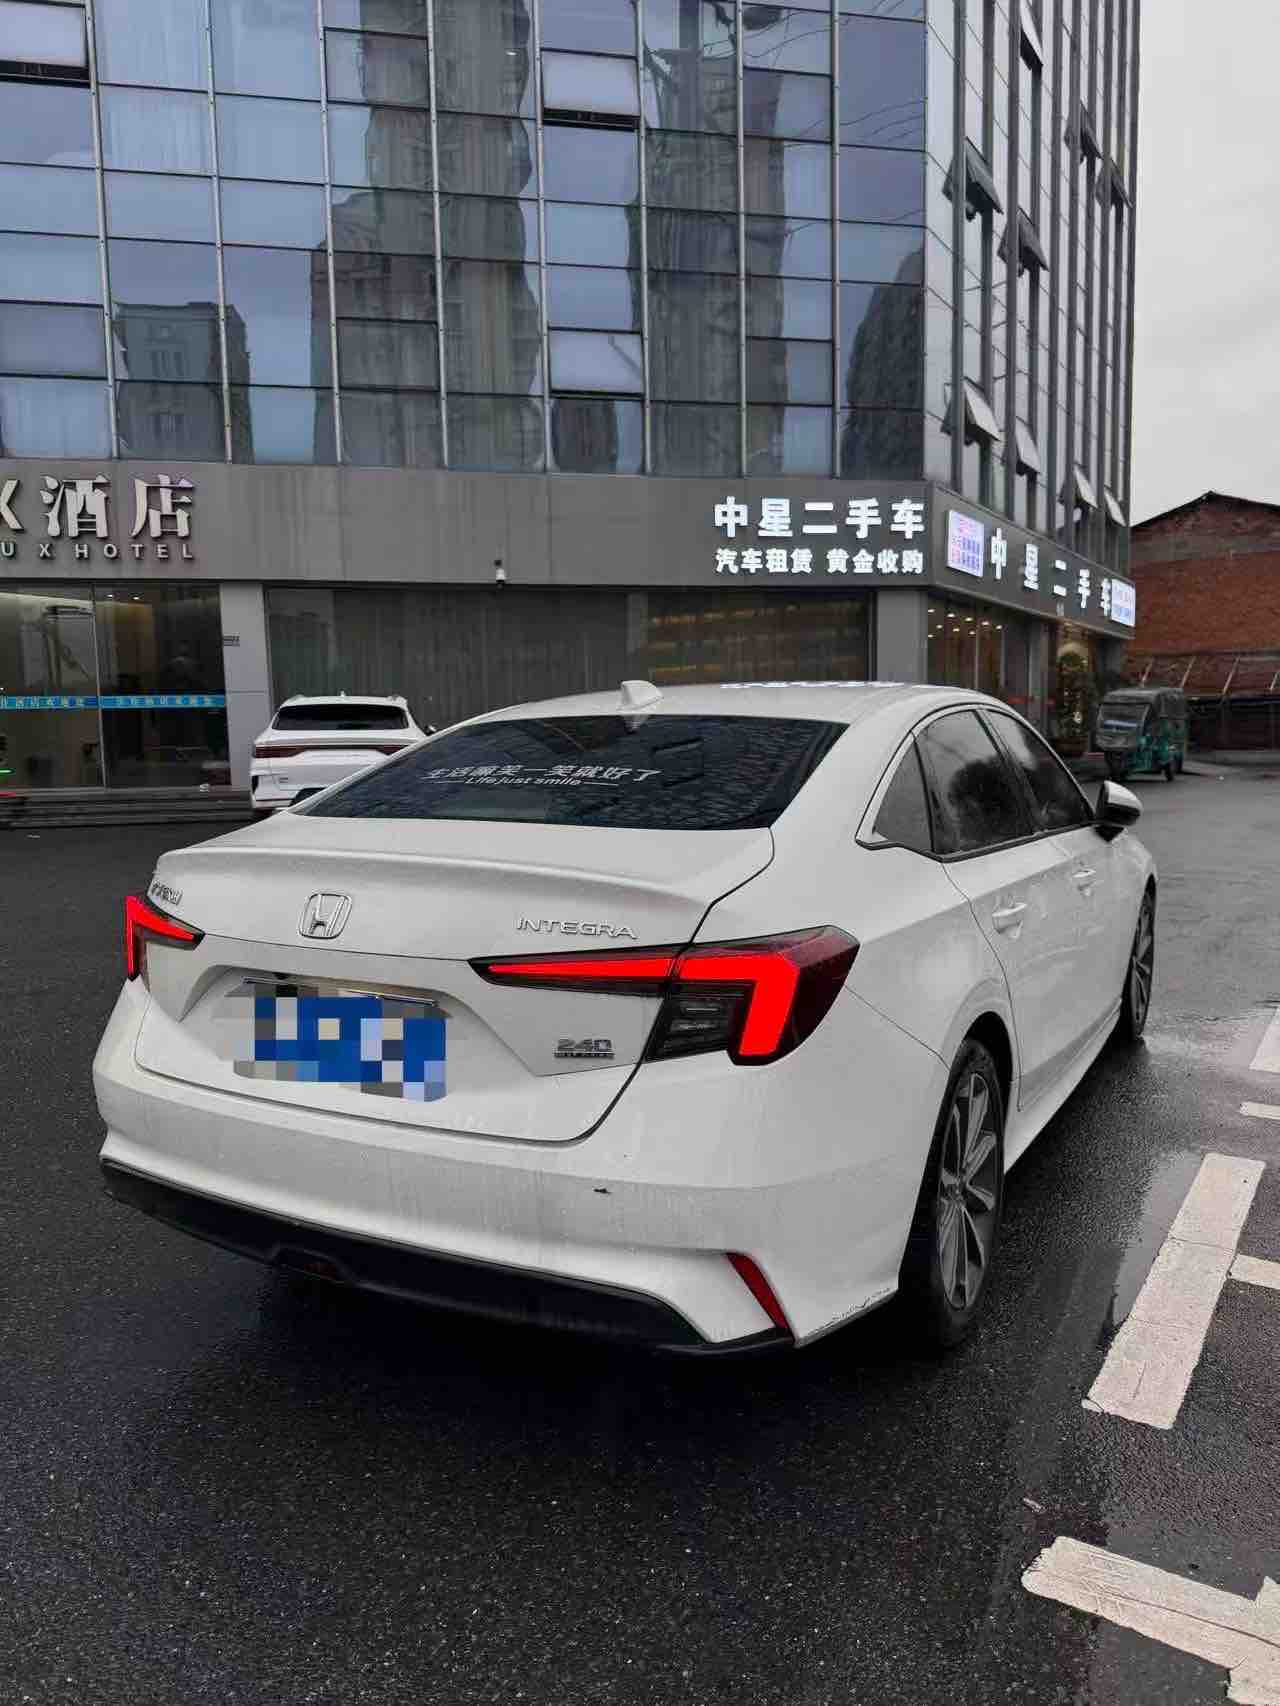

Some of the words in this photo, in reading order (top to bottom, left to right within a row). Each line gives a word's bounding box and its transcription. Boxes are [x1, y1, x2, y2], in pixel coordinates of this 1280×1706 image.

[714, 496, 925, 539] 中星二手车
[75, 543, 194, 559] HOTEL
[715, 548, 813, 574] 汽车租赁
[826, 548, 924, 574] 黄金收购
[516, 918, 638, 940] INTEGRA
[557, 1039, 612, 1053] 240
